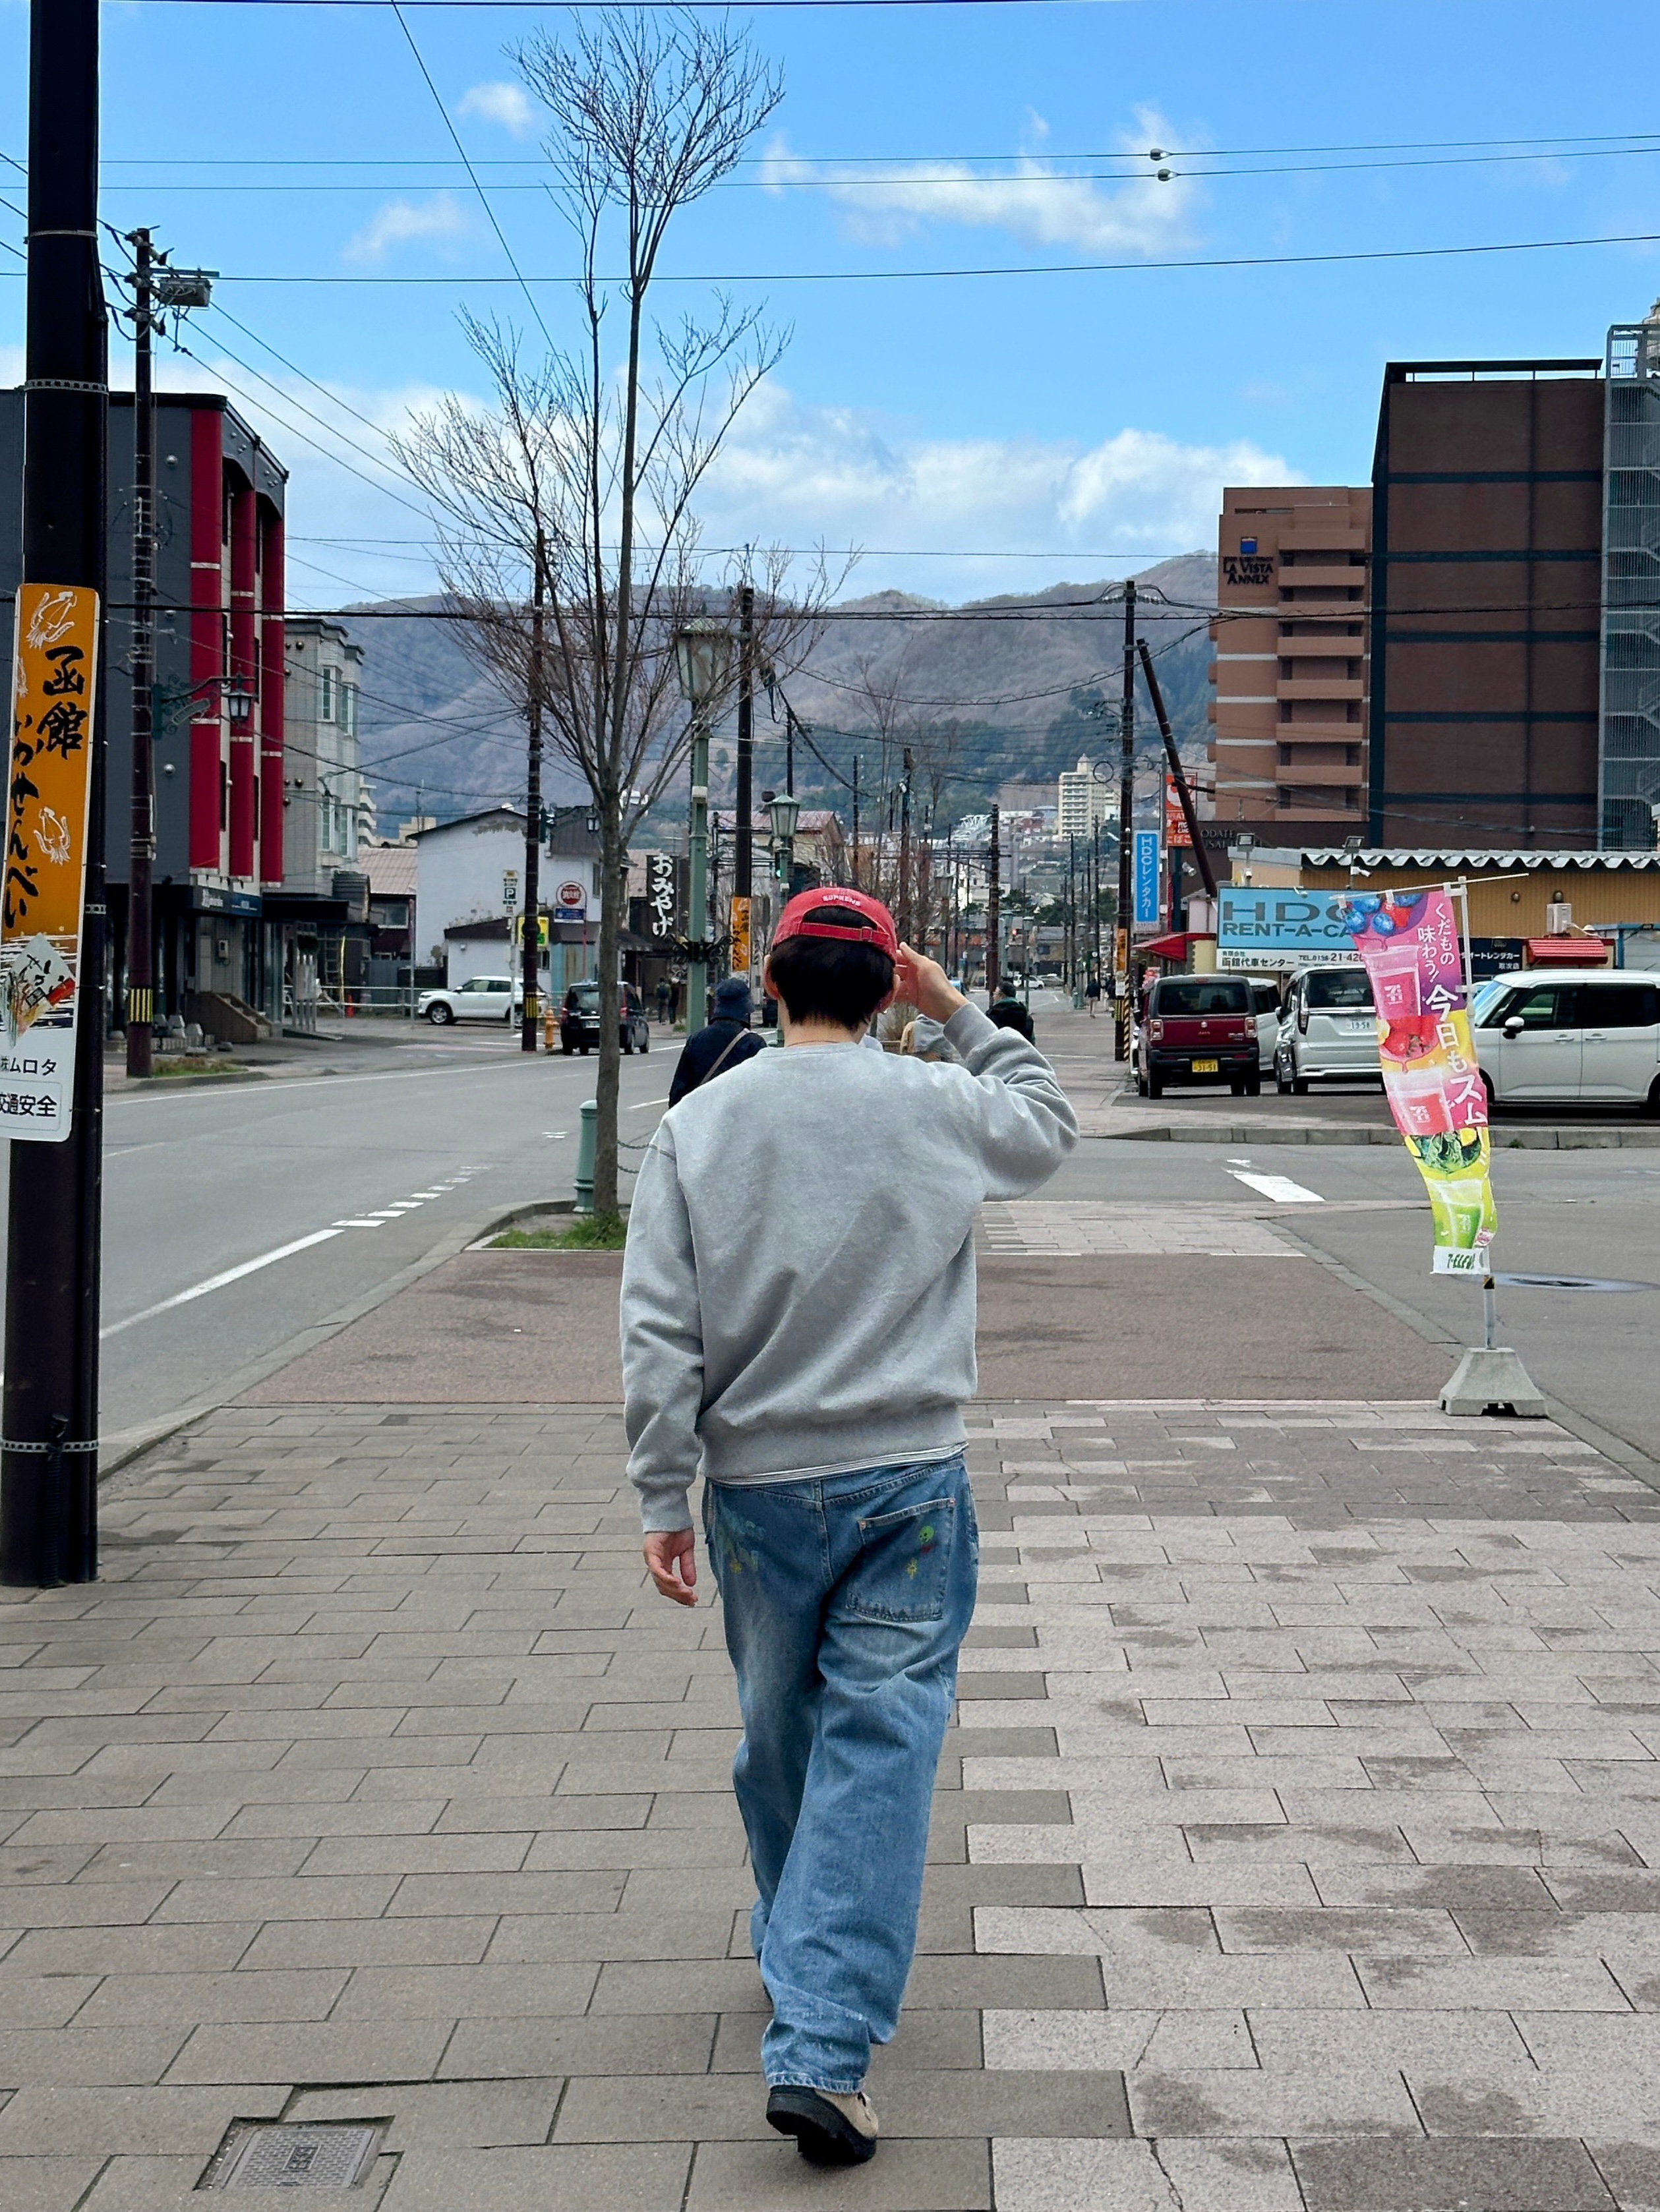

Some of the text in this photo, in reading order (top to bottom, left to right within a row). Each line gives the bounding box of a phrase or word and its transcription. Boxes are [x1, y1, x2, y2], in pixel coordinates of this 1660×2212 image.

[1228, 573, 1269, 585] ANNEX
[1239, 557, 1273, 573] VISTA
[37, 645, 88, 760] 函館
[650, 853, 674, 937] おみやげ
[1141, 836, 1153, 918] HDCレンタカー
[1222, 923, 1353, 937] RENT-A-CA
[1417, 924, 1440, 983] 味わう！
[1435, 902, 1455, 966] くだもの
[1222, 957, 1294, 967] 函館代車センター
